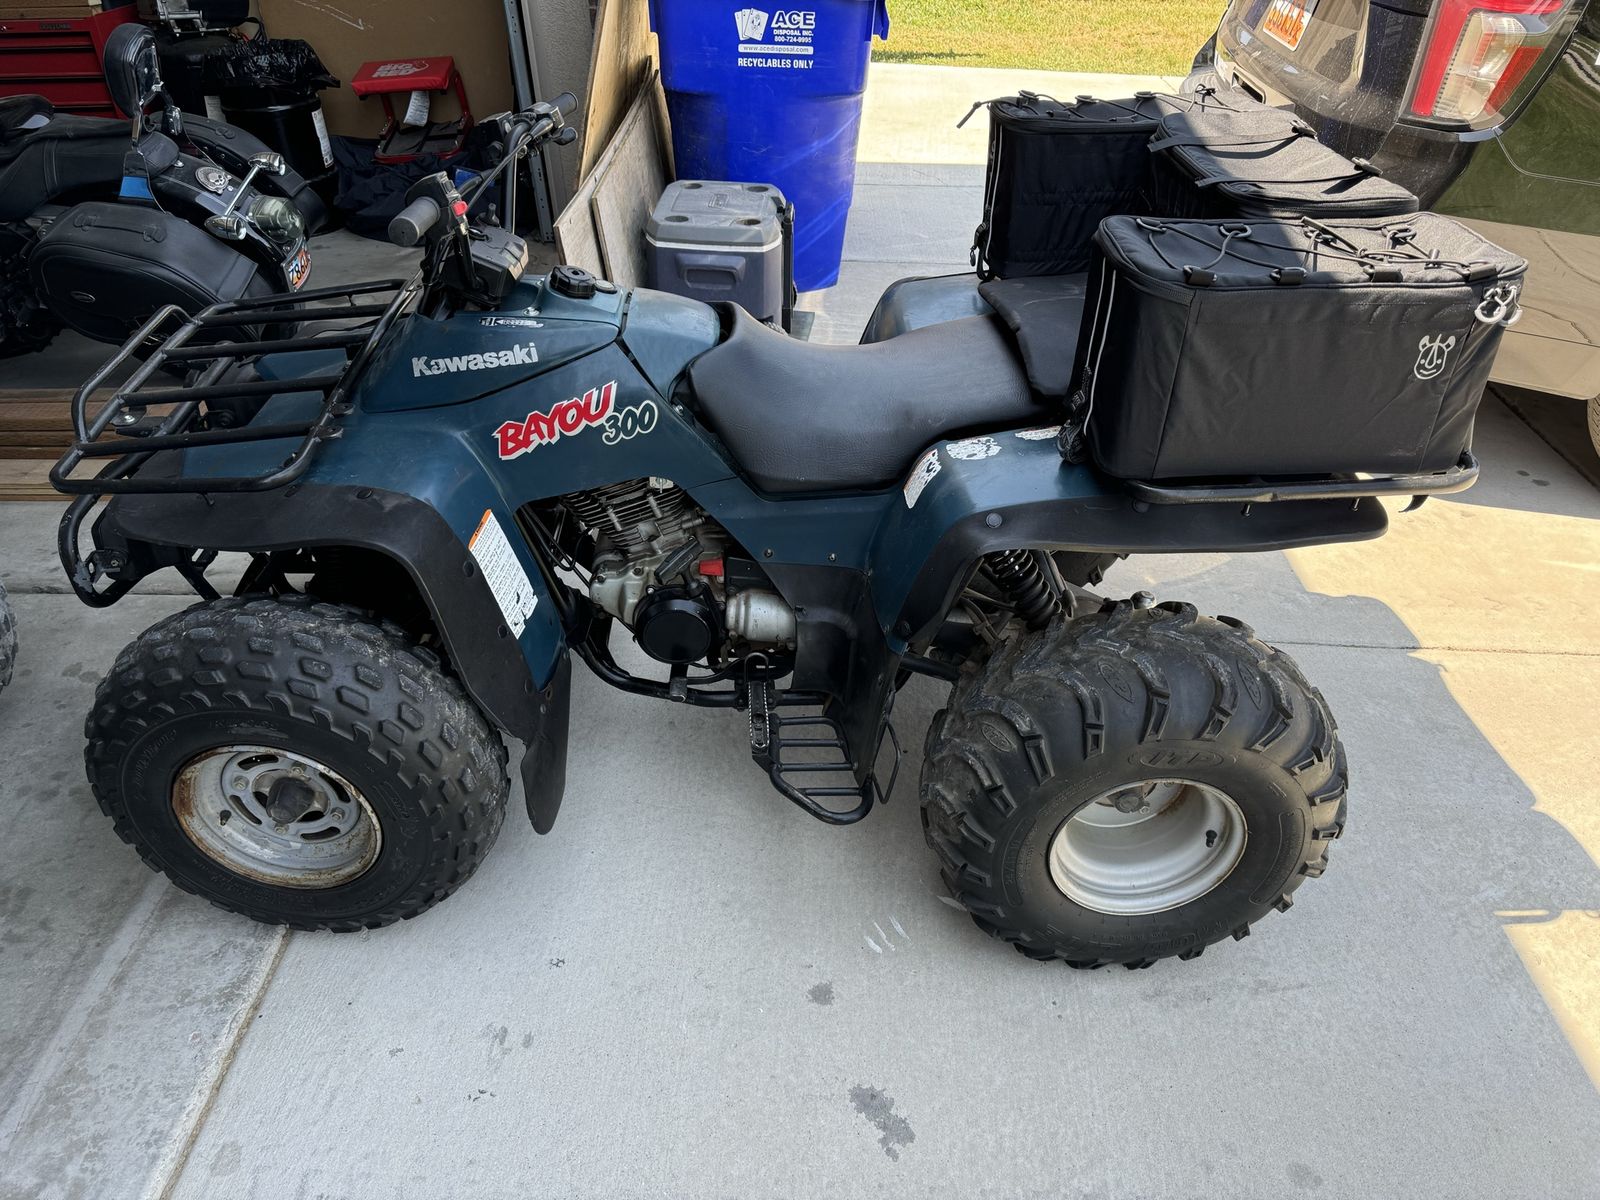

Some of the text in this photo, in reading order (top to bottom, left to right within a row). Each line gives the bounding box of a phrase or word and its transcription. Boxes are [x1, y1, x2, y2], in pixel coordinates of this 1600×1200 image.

[771, 10, 815, 29] ACE
[738, 58, 814, 69] RECYCLABLES ONLY
[411, 342, 539, 378] Kawasaki
[492, 380, 618, 461] BAYOU
[602, 400, 658, 445] 300
